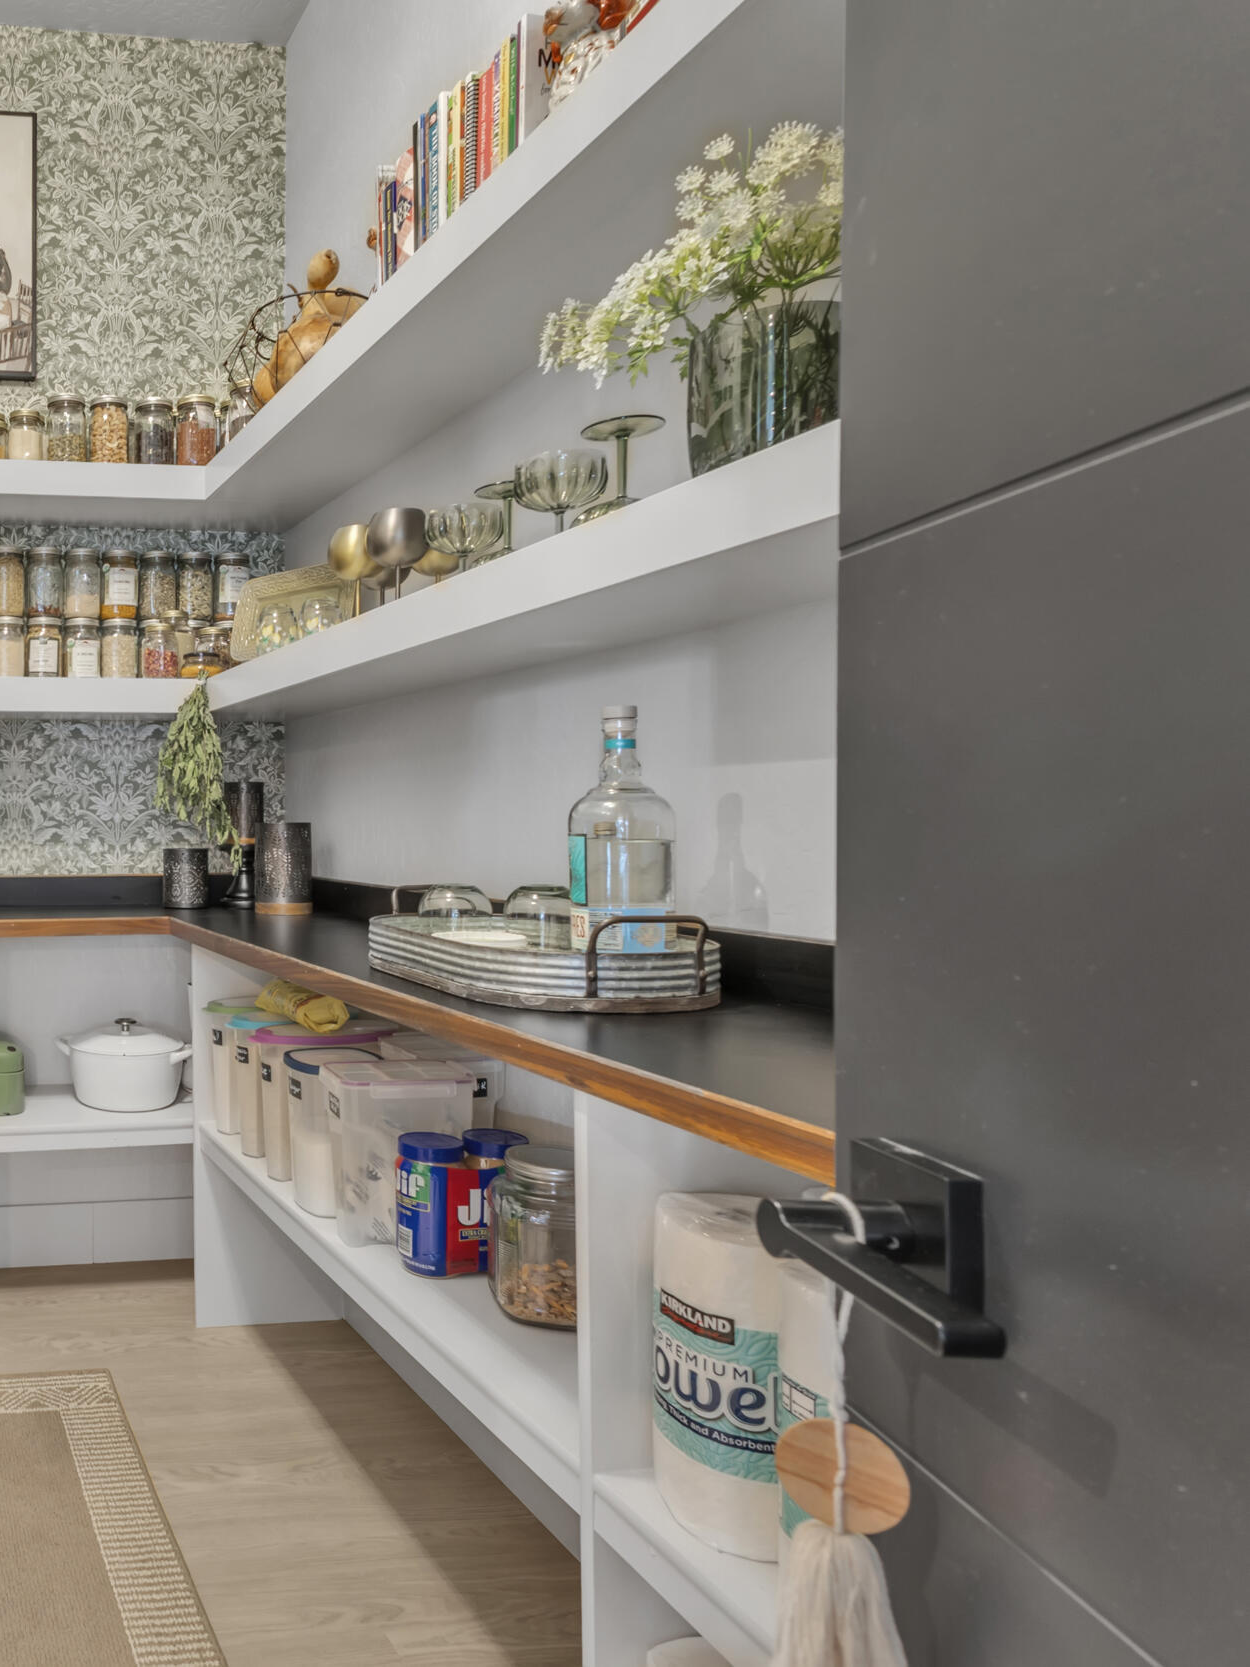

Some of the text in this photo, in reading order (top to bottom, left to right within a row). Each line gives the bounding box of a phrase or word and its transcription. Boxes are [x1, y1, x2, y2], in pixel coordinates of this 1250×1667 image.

[457, 1188, 490, 1227] Ji
[661, 1291, 732, 1334] KIRKLAND
[669, 1404, 776, 1453] Thick and Absorbent
